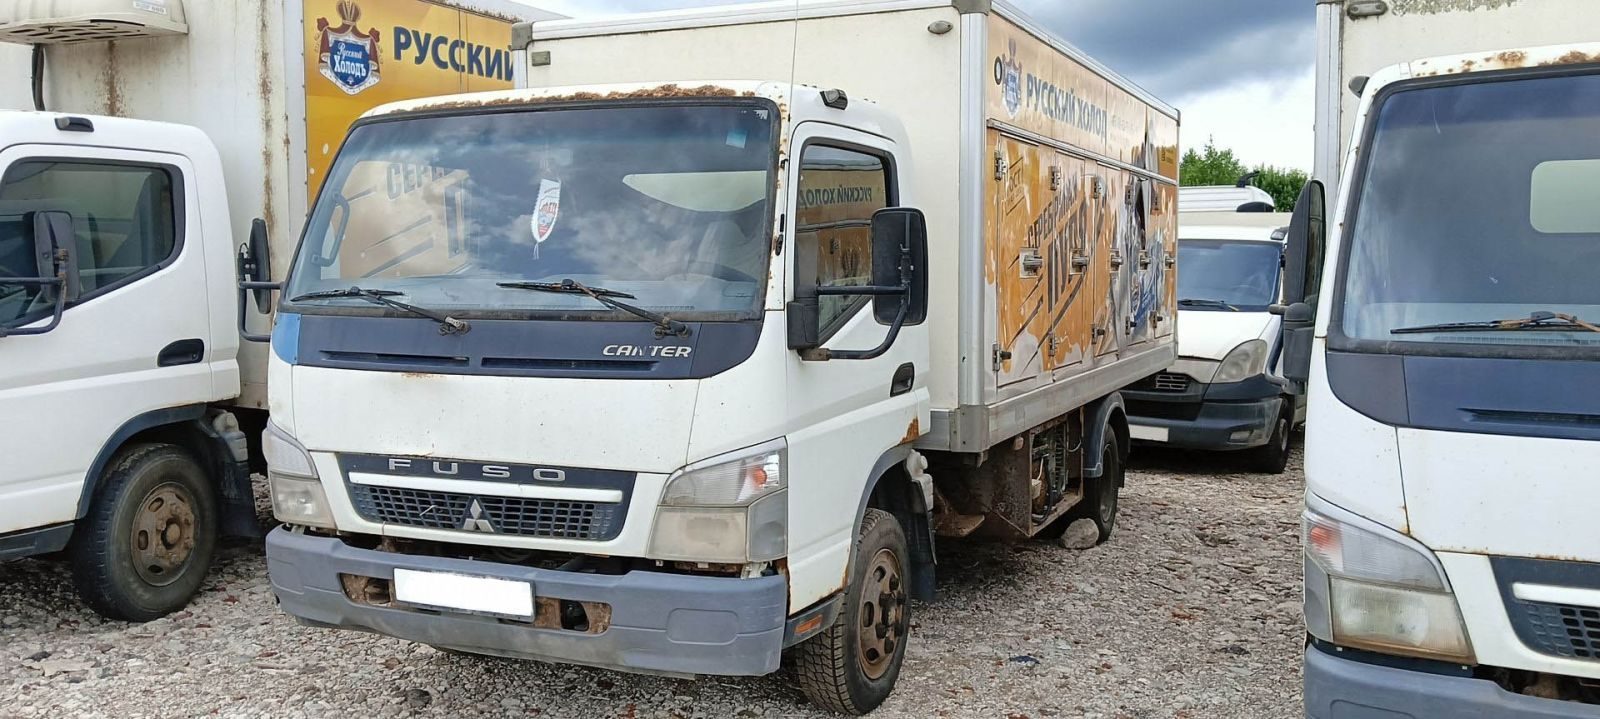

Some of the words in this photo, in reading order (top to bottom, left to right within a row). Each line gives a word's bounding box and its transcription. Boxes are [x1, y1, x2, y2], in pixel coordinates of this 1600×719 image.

[1026, 73, 1074, 125] РУССКИЙ
[1077, 98, 1107, 144] ХОЛОД
[602, 345, 692, 358] CANTER
[388, 458, 566, 482] FUSO
